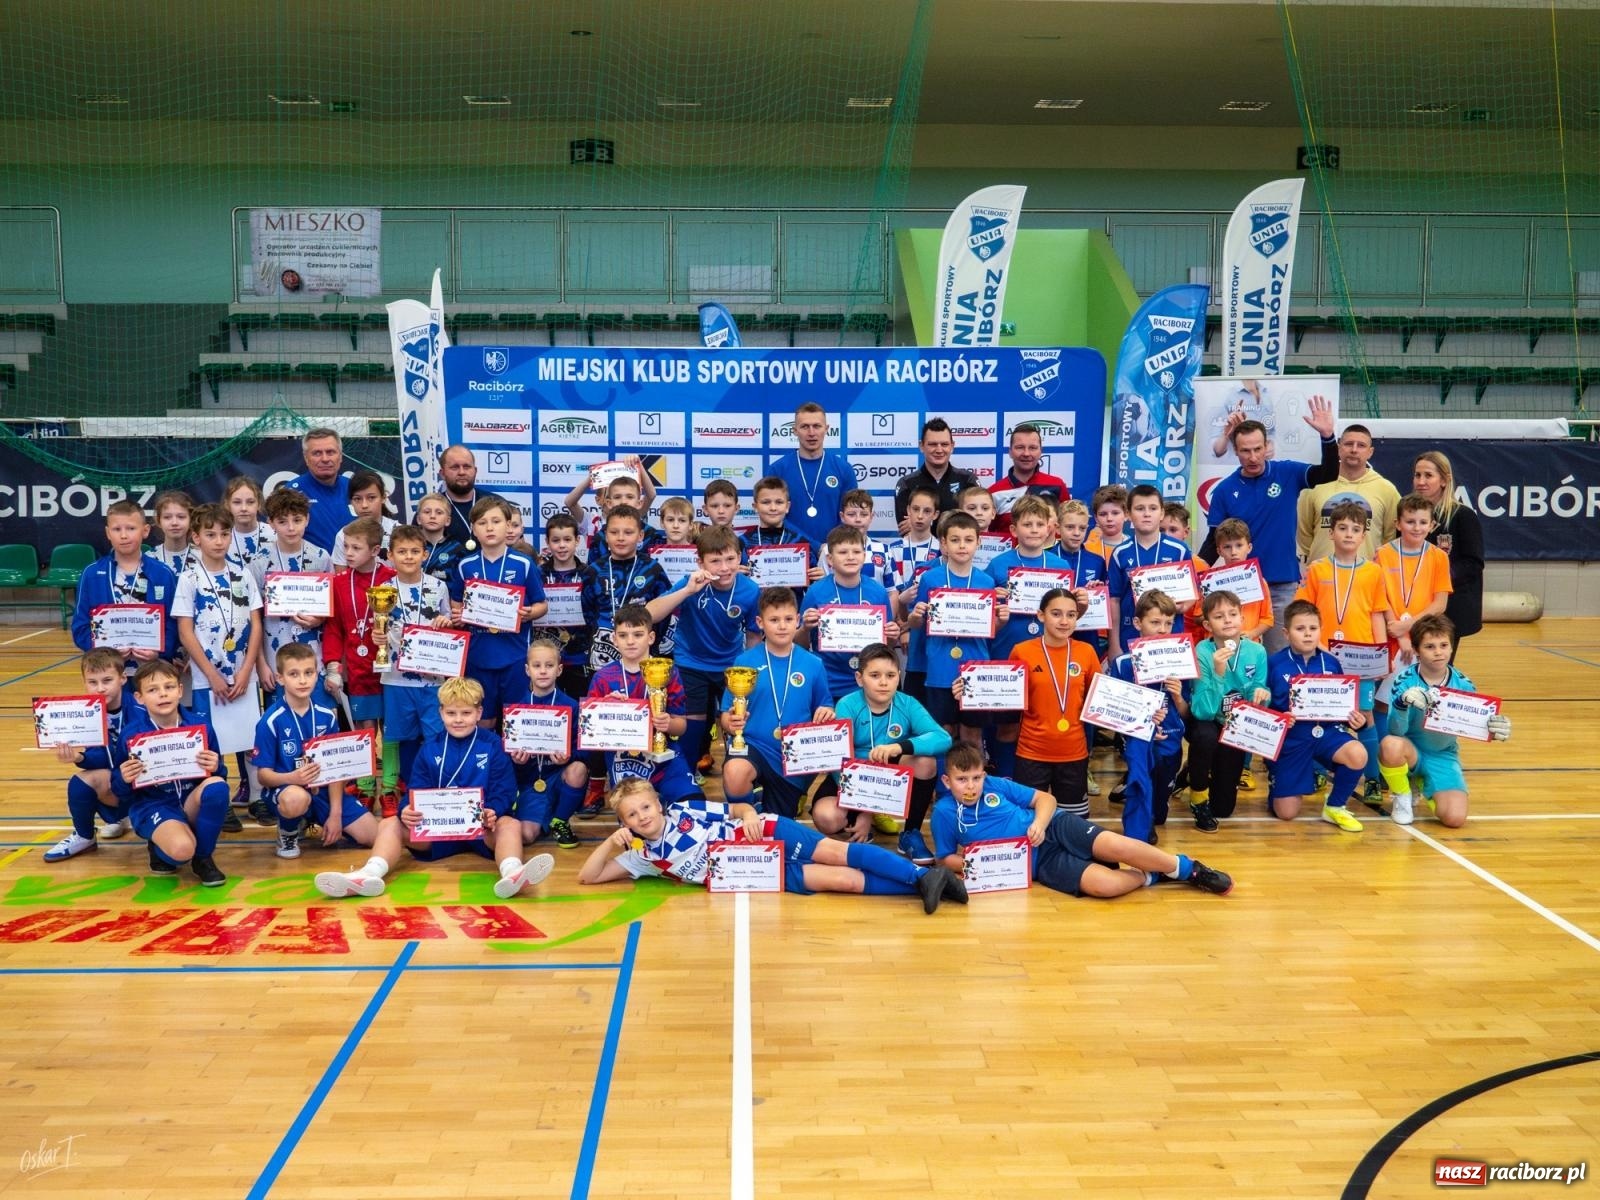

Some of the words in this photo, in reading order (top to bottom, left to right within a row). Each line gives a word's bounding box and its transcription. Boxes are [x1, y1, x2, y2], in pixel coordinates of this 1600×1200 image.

[265, 213, 364, 232] MIESZKO
[970, 228, 1002, 246] UNIA
[1252, 224, 1285, 244] UNIA
[943, 265, 956, 320] SPORTOWY
[1230, 264, 1240, 318] SPORTOWY
[977, 268, 1003, 346] IBÓRZ
[952, 291, 978, 346] NIA
[1264, 263, 1288, 376] ACIBÓRZ
[1241, 287, 1265, 366] UNIA
[1149, 345, 1186, 370] UNIA
[538, 358, 624, 382] MIEJSKI
[633, 360, 690, 382] KLUB
[698, 360, 818, 384] SPORTOWY
[824, 360, 878, 383] UNIA
[886, 353, 998, 382] RACIBÓRZ
[1024, 368, 1056, 388] UNIA
[469, 381, 524, 392] Racibórz
[1120, 401, 1133, 478] SPORTOWY
[542, 464, 571, 472] BOXY
[870, 466, 916, 477] SPORT
[997, 544, 1005, 552] CUP
[1147, 575, 1162, 583] WINTER
[1162, 573, 1176, 582] FUTSAL
[1215, 577, 1230, 586] WINTER
[1230, 574, 1244, 584] FUTSAL
[478, 592, 491, 601] WINTER
[493, 595, 505, 604] FUTSAL
[869, 618, 877, 626] CUP
[418, 639, 434, 647] WINTER
[435, 640, 450, 649] FUTSAL
[451, 642, 459, 650] CUP
[1148, 648, 1163, 656] WINTER
[1163, 647, 1177, 655] FUTSAL
[1178, 646, 1186, 654] CUP
[1447, 702, 1463, 712] WINTER
[1464, 704, 1479, 714] FUTSAL
[1480, 707, 1488, 716] CUP
[522, 718, 537, 726] WINTER
[538, 719, 553, 727] FUTSAL
[598, 713, 615, 721] WINTER
[1244, 716, 1257, 727] WINTER
[1258, 720, 1271, 730] FUTSAL
[800, 736, 816, 744] WINTER
[817, 735, 833, 743] FUTSAL
[149, 745, 167, 754] WINTER
[168, 743, 185, 752] FUTSAL
[186, 742, 195, 750] CUP
[322, 748, 338, 757] WINTER
[339, 745, 355, 755] FUTSAL
[356, 744, 364, 752] CUP
[615, 761, 650, 778] BESKID
[859, 774, 875, 783] WINTER
[876, 776, 892, 785] FUTSAL
[727, 855, 745, 863] WINTER
[746, 855, 763, 863] FUTSAL
[764, 855, 773, 863] CUP
[981, 854, 996, 862] WINTER
[997, 853, 1012, 861] FUTSAL
[0, 903, 549, 956] RAFAKO
